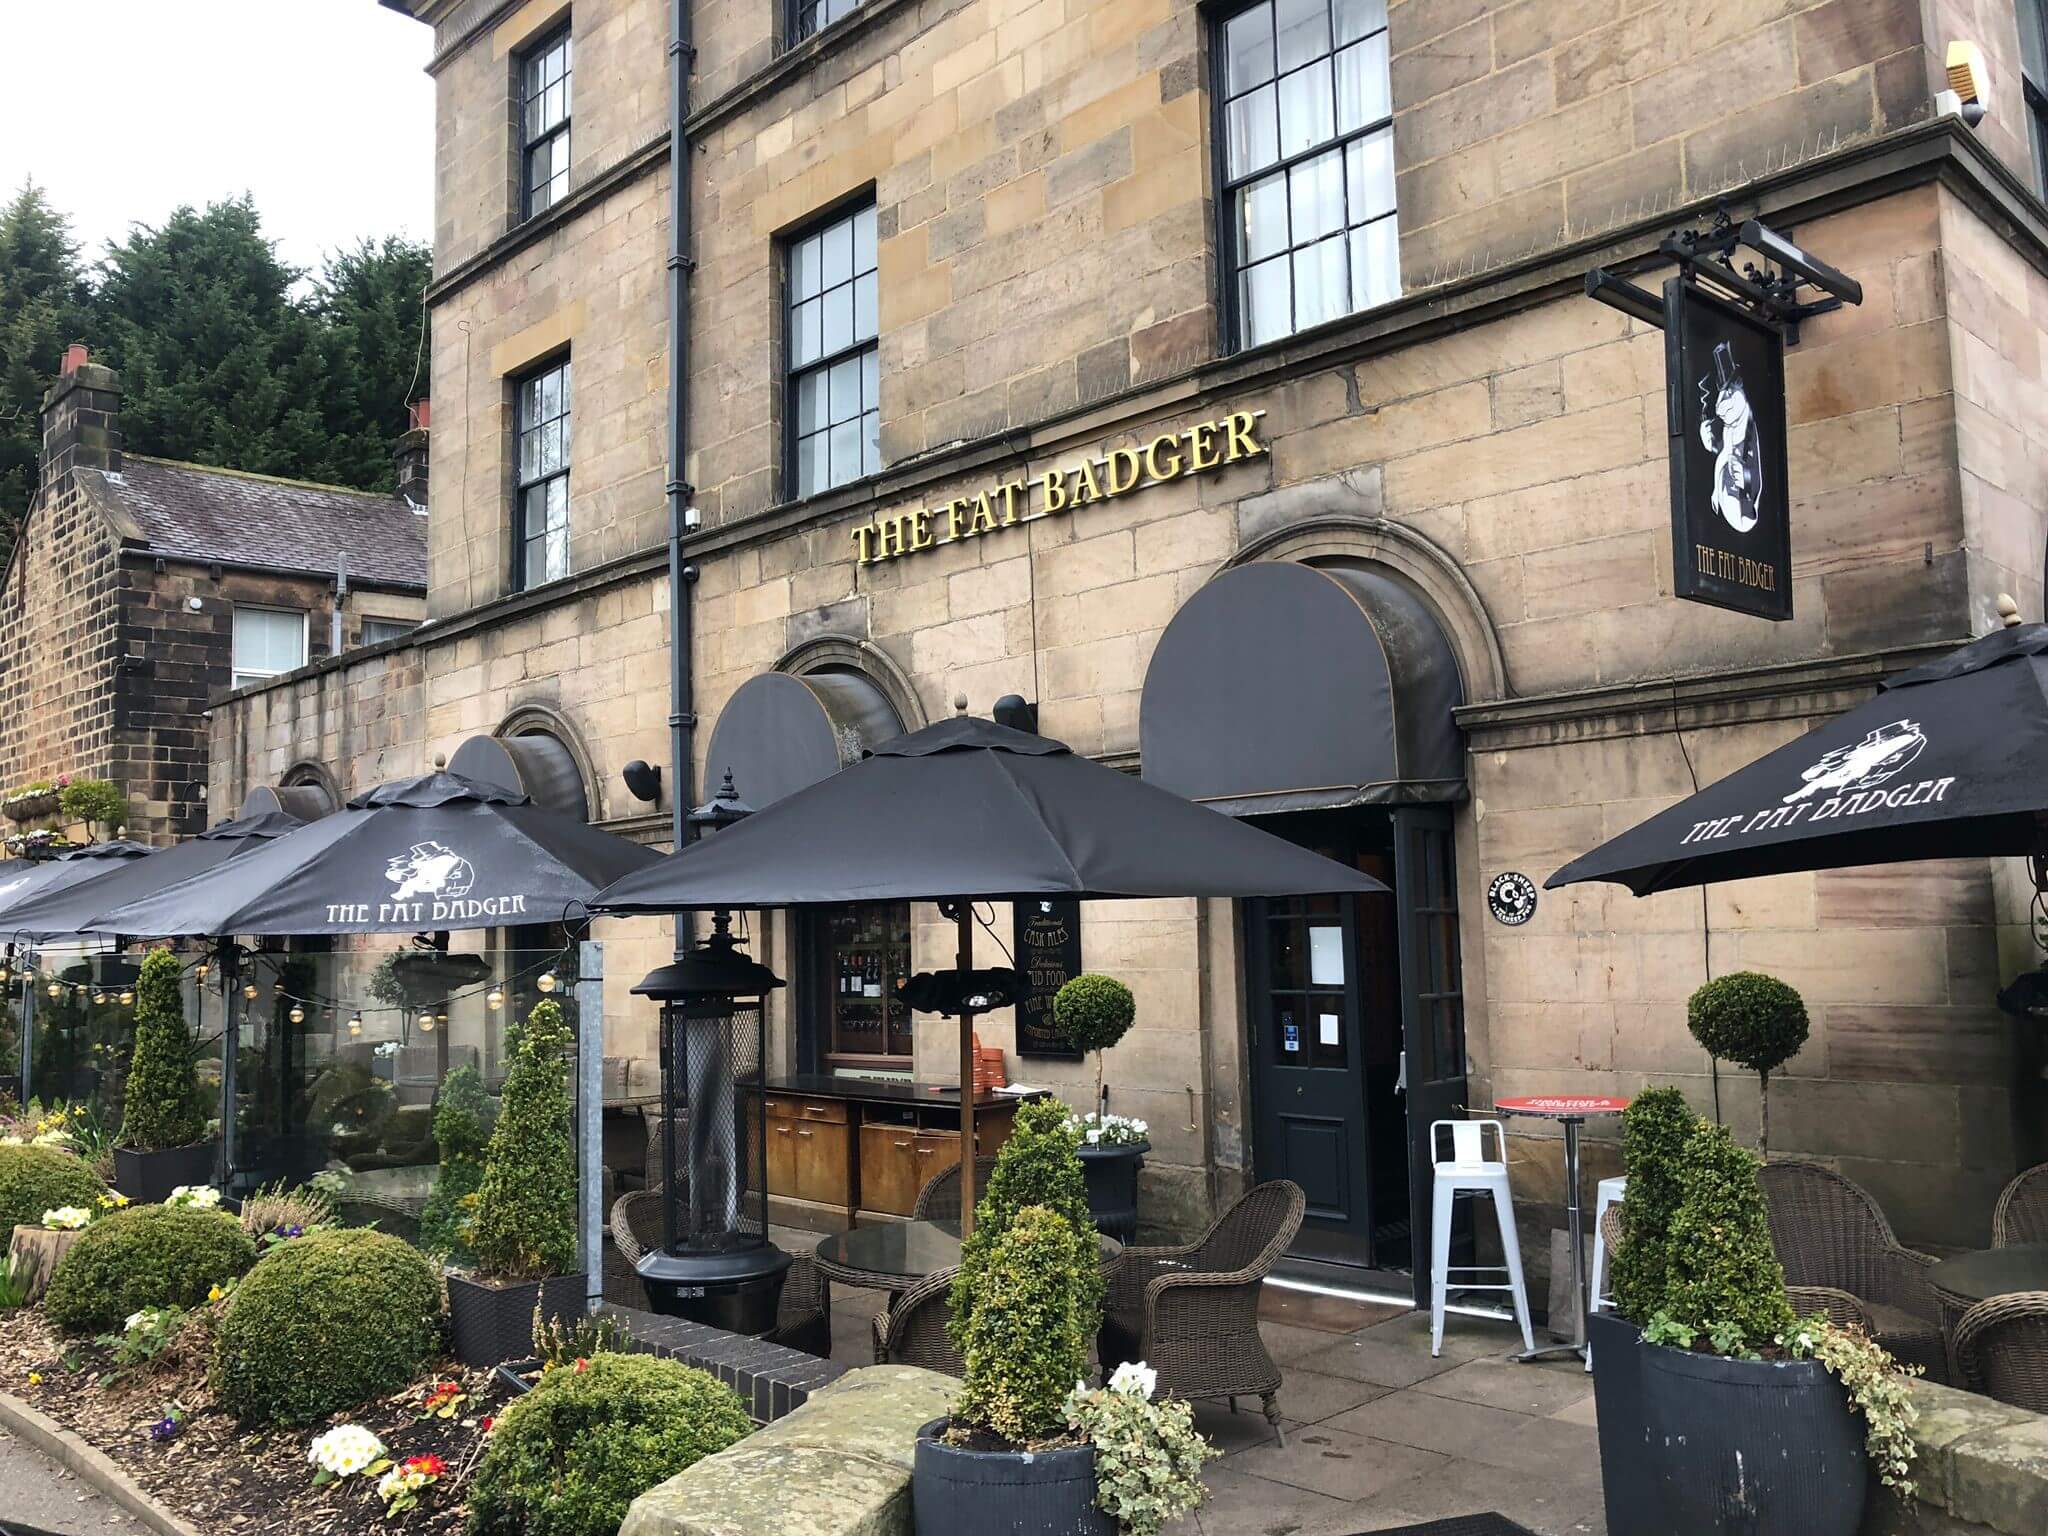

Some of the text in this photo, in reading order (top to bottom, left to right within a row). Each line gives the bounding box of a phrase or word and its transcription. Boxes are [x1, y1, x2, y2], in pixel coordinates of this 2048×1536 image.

[851, 410, 1267, 566] THE FAT BADGER
[1696, 543, 1776, 592] THE FAT BADGER
[1680, 776, 1956, 845] THE FAT BADGER
[1488, 873, 1536, 900] BLACK SHEEP
[326, 894, 527, 924] THE FAT BADGER
[1024, 927, 1069, 947] CASK ALES
[1046, 970, 1068, 986] FOOD
